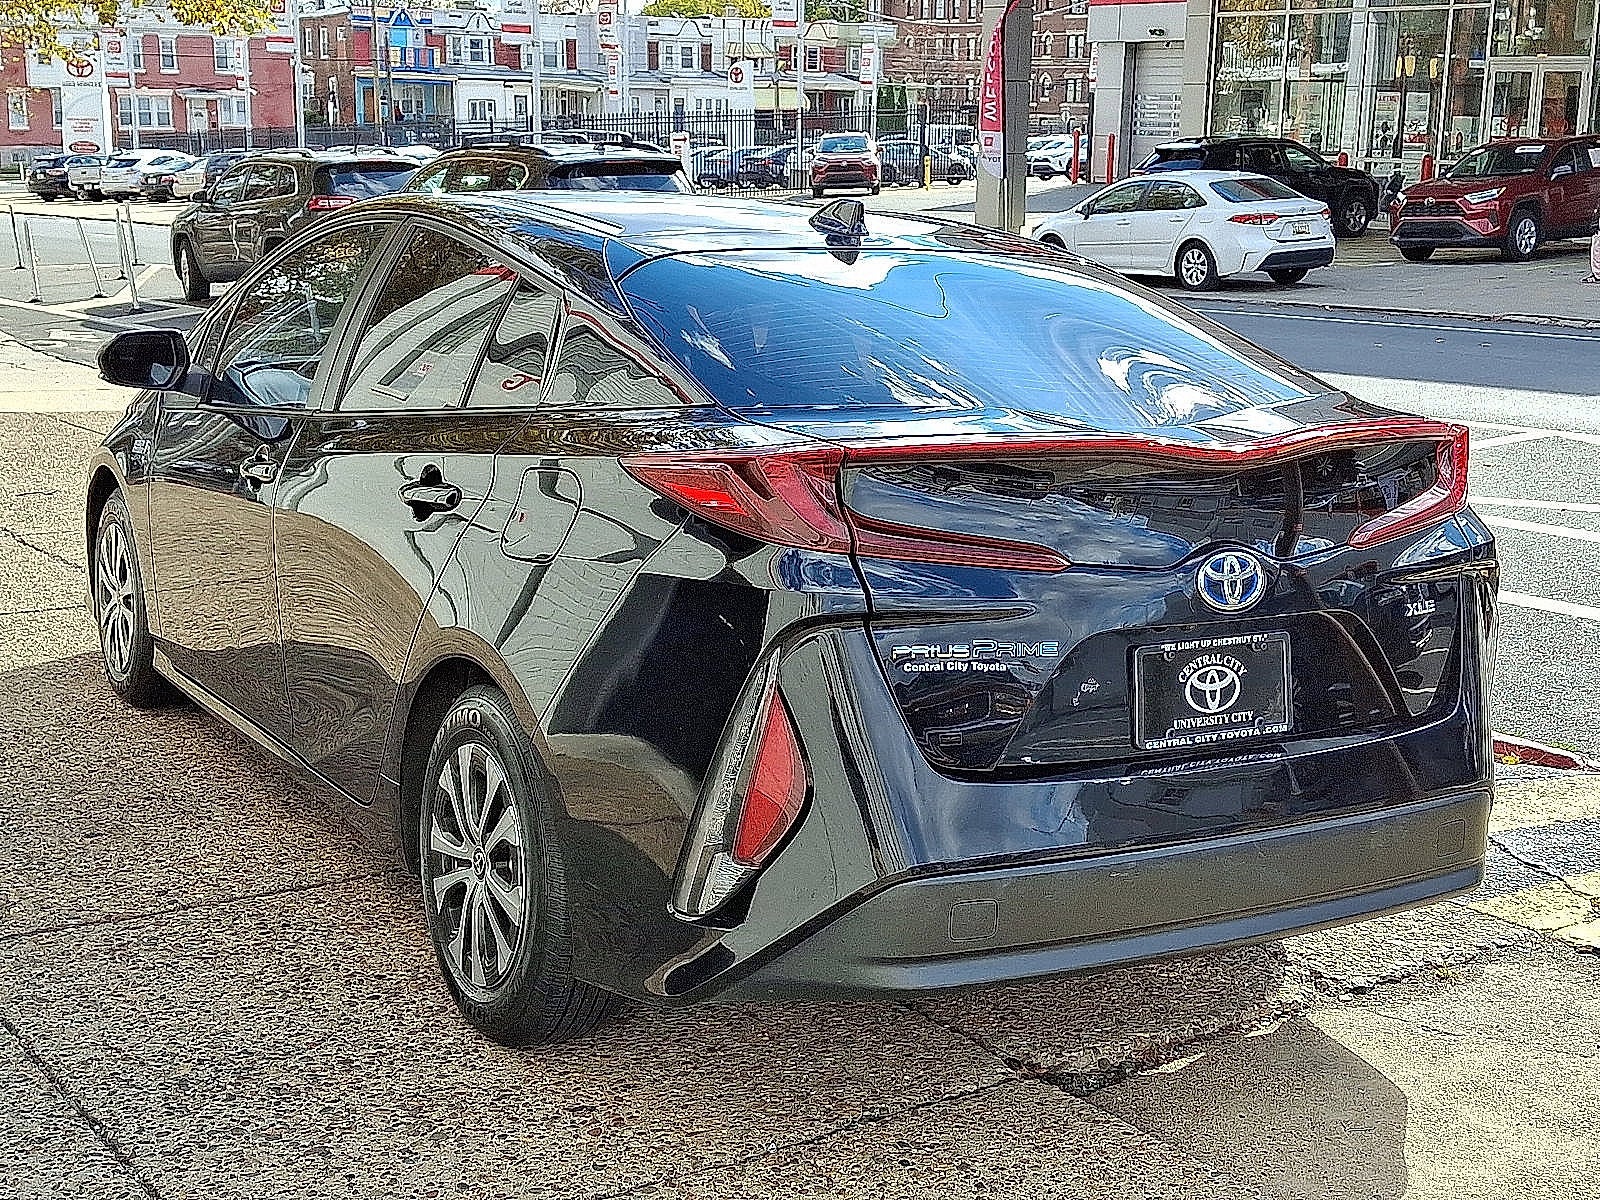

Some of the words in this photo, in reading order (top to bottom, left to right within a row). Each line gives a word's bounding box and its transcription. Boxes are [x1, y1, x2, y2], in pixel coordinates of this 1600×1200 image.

[1404, 599, 1436, 617] XLE
[892, 645, 970, 660] PRIUS
[972, 639, 1059, 658] PRIME
[1177, 641, 1199, 651] LIGHT
[1200, 640, 1212, 648] UP
[1212, 636, 1252, 647] CHESTNUT
[903, 662, 944, 672] Central
[946, 661, 968, 672] City
[970, 661, 1007, 672] Toyota
[1178, 653, 1225, 684] CENTRAL
[1222, 654, 1248, 677] CITY
[1173, 713, 1231, 730] UNIVERSITY
[1231, 710, 1254, 723] CITY
[1145, 738, 1193, 750] CENTRAL
[1195, 734, 1218, 744] CITY
[1217, 728, 1260, 741] TOYOTA
